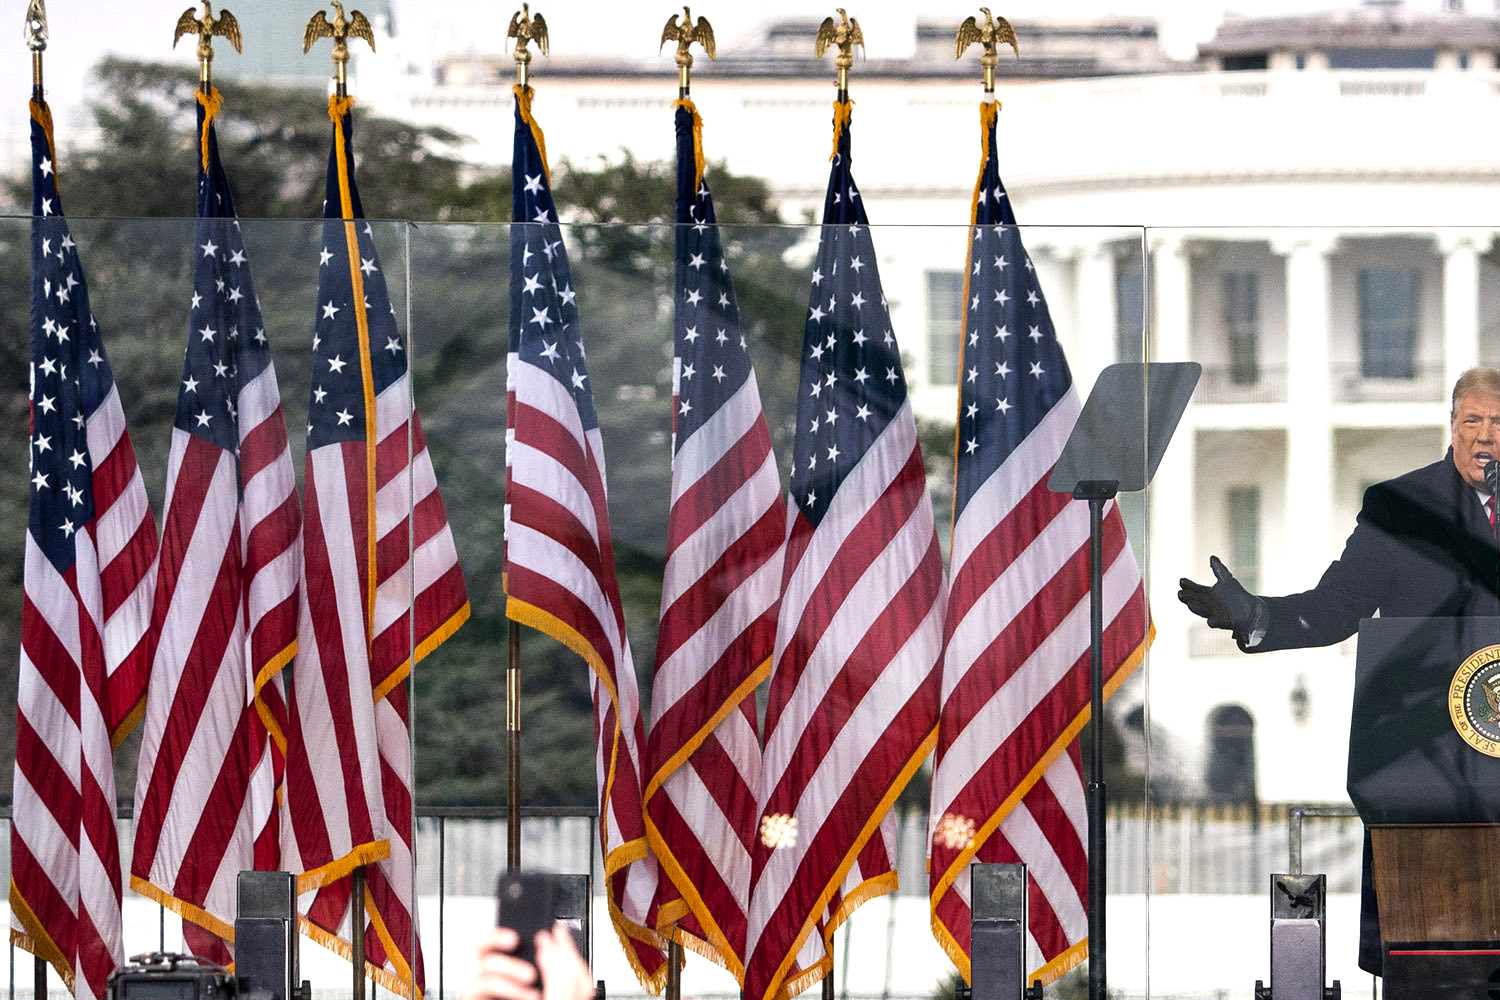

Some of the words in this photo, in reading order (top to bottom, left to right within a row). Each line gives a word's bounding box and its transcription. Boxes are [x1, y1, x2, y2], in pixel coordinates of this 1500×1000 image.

[1454, 703, 1464, 719] THE
[1458, 721, 1469, 731] OF
[1468, 729, 1497, 753] SEAL
